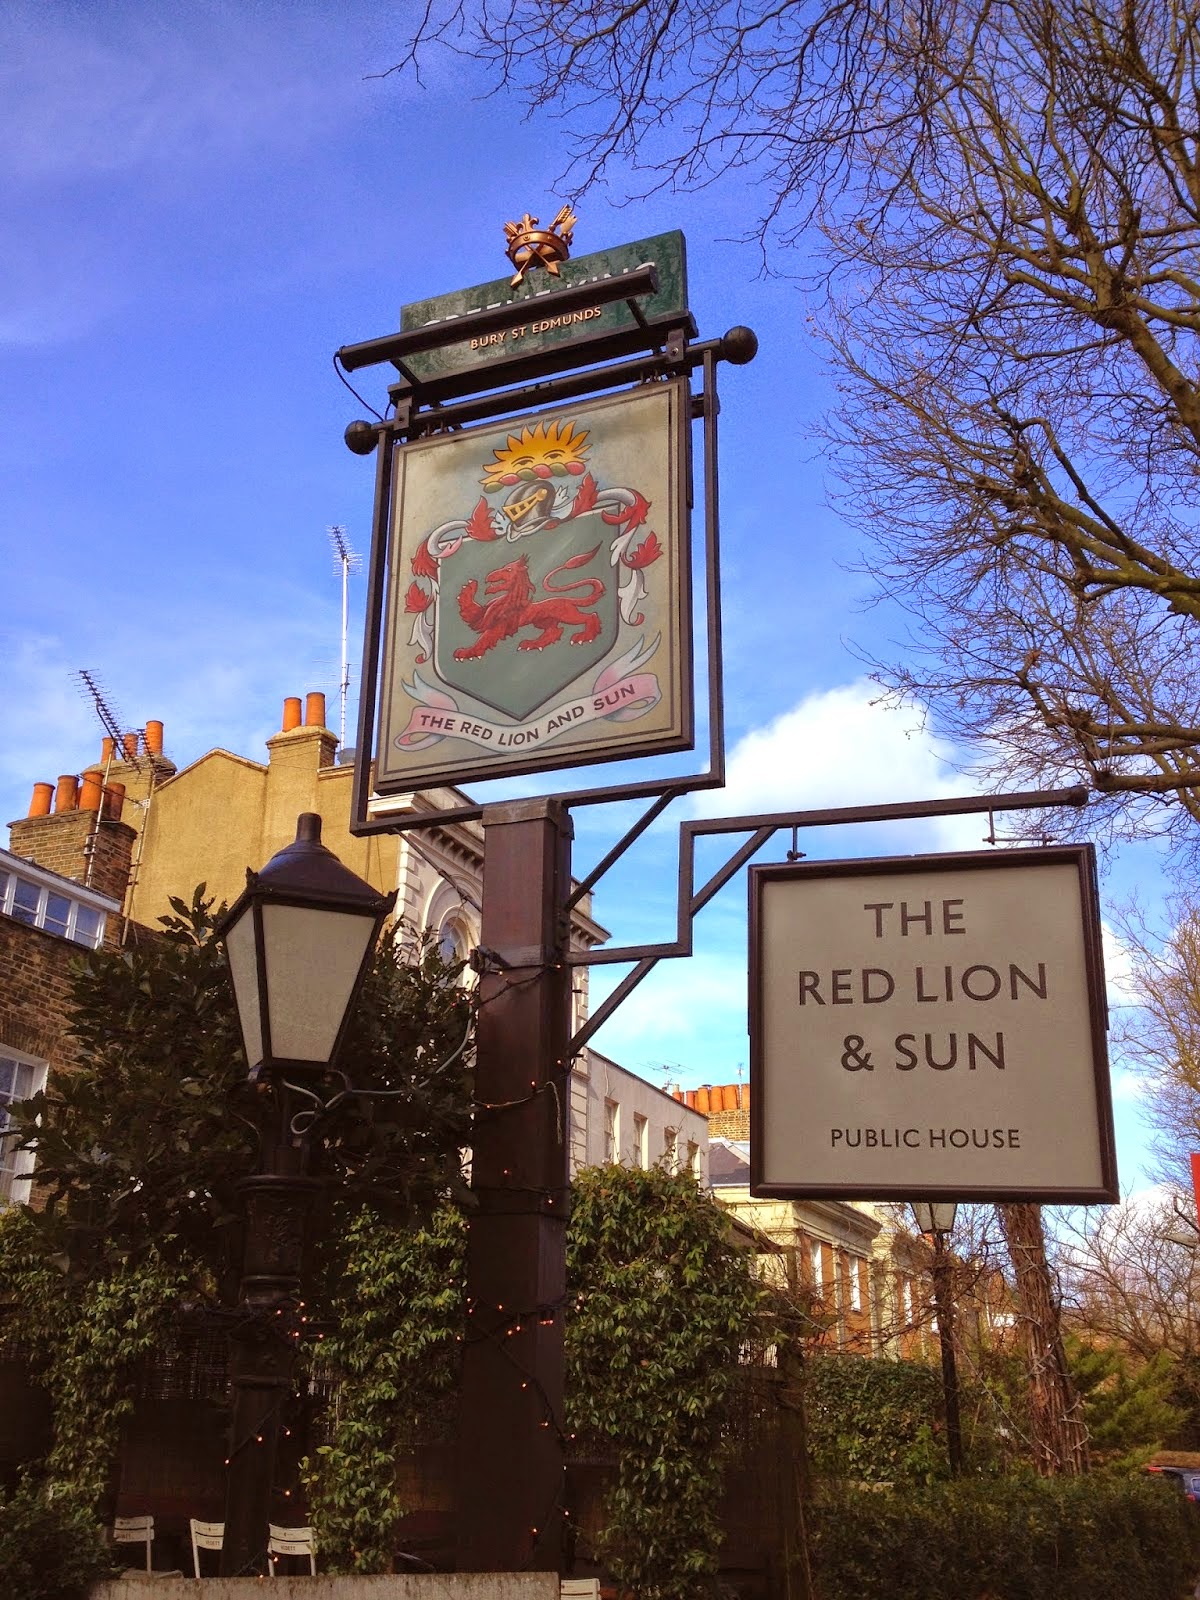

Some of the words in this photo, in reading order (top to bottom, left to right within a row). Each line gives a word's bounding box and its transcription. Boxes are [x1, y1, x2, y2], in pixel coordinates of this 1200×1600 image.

[470, 331, 507, 349] BURY
[511, 326, 527, 340] ST
[532, 306, 602, 334] EDMUNDS
[420, 714, 455, 731] THE
[460, 722, 493, 741] RED
[497, 727, 540, 747] LION
[546, 705, 586, 733] AND
[593, 683, 637, 711] SUN
[863, 899, 967, 938] THE
[799, 968, 896, 1006] RED
[915, 963, 1048, 1003] LION
[840, 1034, 875, 1072] &
[894, 1031, 1006, 1071] SUN
[831, 1128, 921, 1149] PUBLIC
[929, 1128, 1021, 1149] HOUSE
